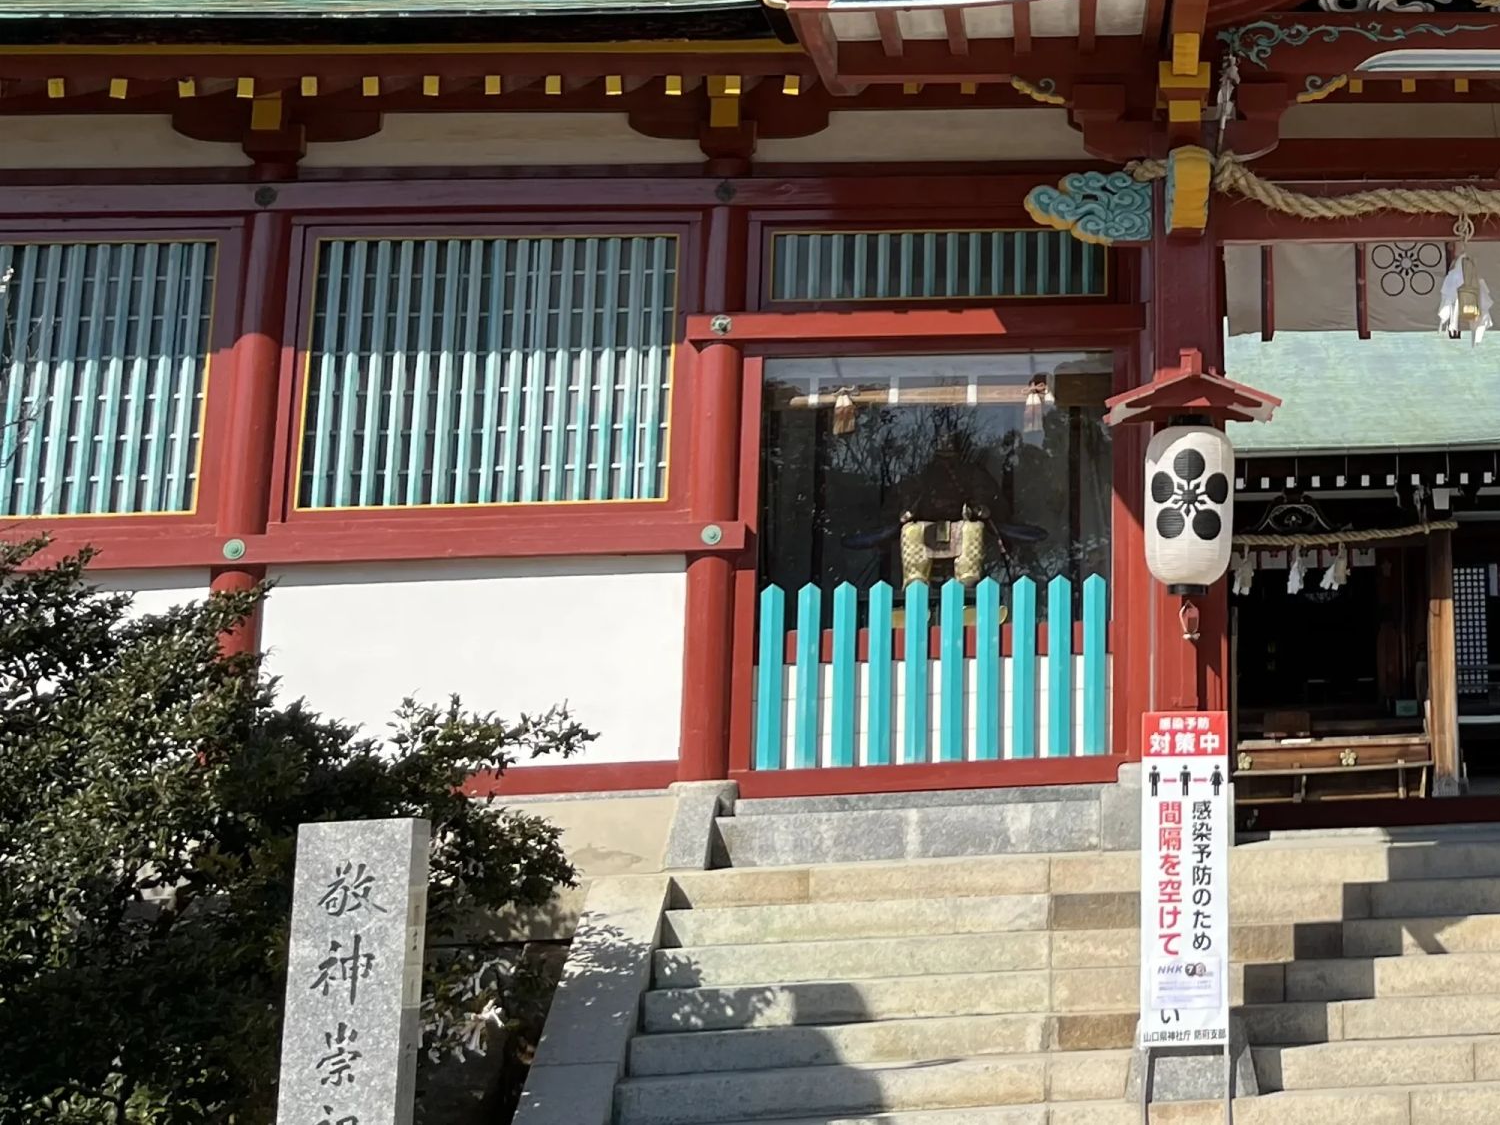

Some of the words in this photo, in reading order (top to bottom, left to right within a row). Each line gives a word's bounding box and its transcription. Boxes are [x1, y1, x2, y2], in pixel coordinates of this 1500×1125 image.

[1150, 732, 1220, 754] 対策中
[1191, 800, 1213, 951] 感染予防のため
